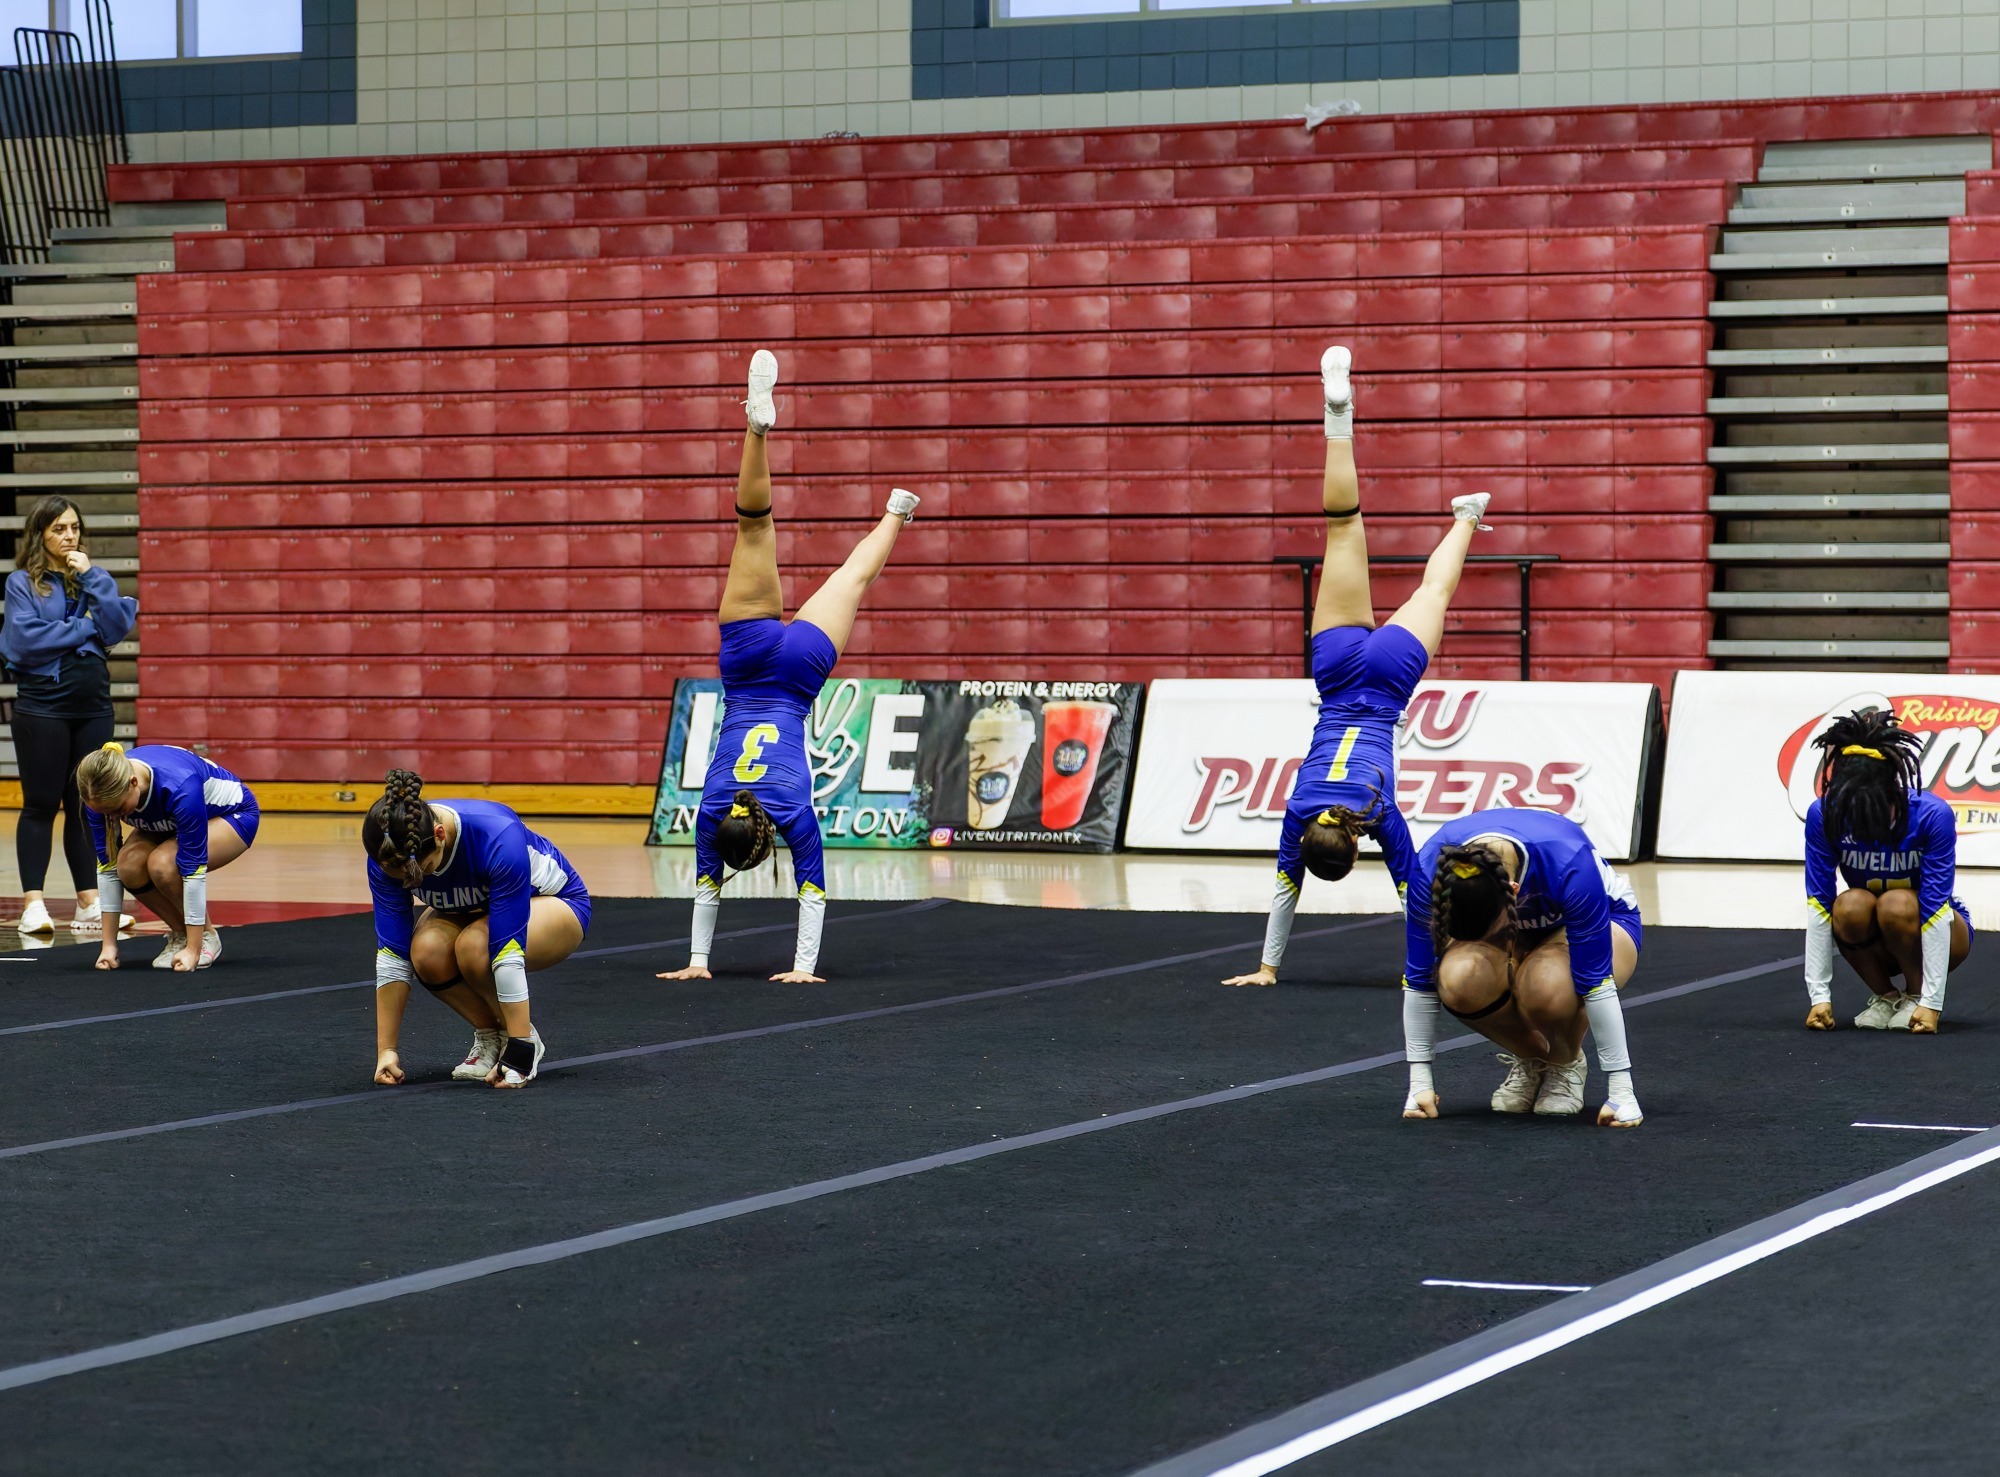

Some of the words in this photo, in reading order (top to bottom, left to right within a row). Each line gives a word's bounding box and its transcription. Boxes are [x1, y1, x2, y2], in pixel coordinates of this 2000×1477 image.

[959, 680, 1032, 697] PROTEIN
[1033, 682, 1050, 698] &
[1051, 682, 1122, 698] ENERGY
[1898, 699, 2000, 731] Raising
[733, 723, 780, 783] 3
[1325, 726, 1362, 782] 1
[1966, 809, 2000, 823] FIN
[952, 829, 1082, 845] LIVENUTRITIONTX
[1840, 849, 1924, 872] JAVELINA
